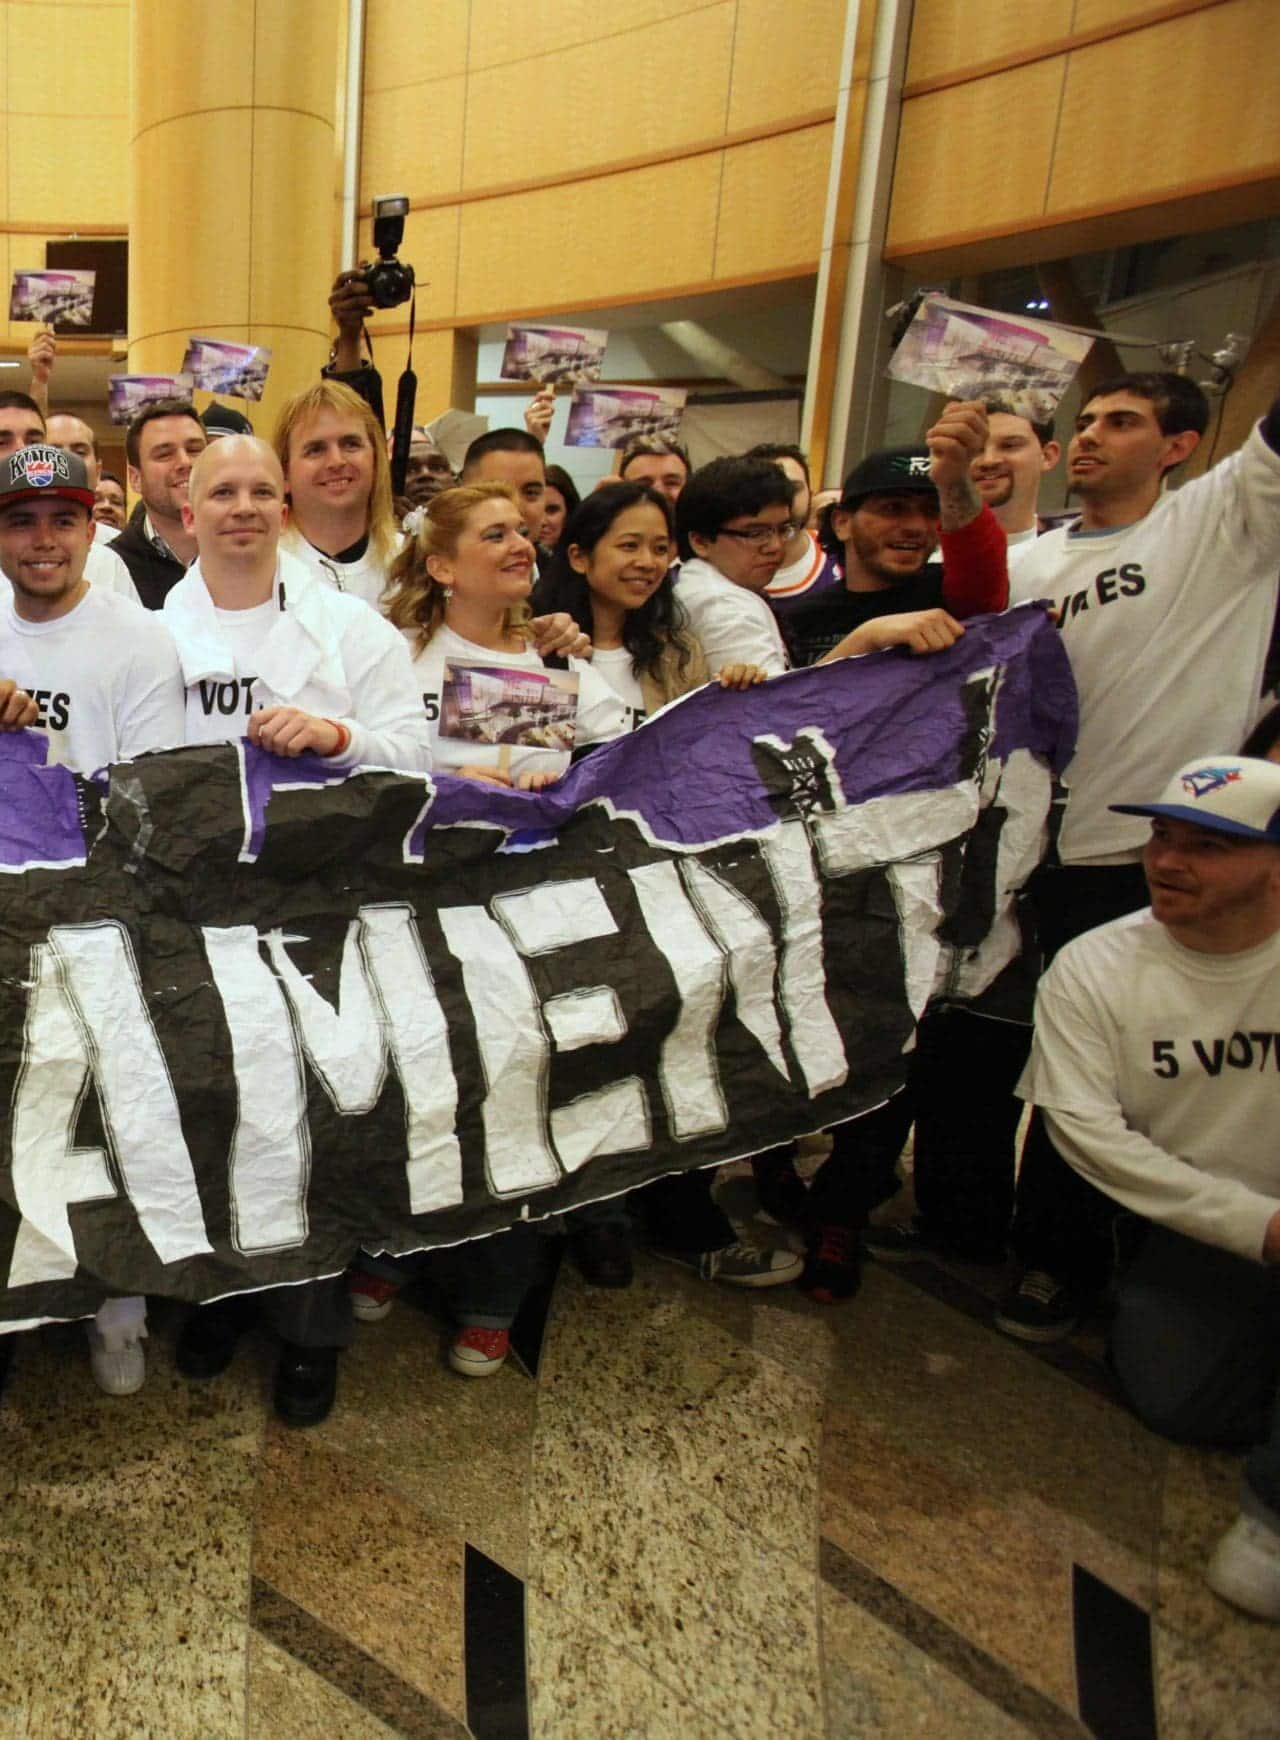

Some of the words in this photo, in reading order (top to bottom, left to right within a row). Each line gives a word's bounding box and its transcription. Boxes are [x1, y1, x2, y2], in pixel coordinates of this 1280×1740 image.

[9, 448, 70, 485] KINGS
[25, 688, 71, 731] ES
[199, 676, 264, 716] VOT
[422, 692, 440, 721] 5
[1152, 1039, 1180, 1080] 5
